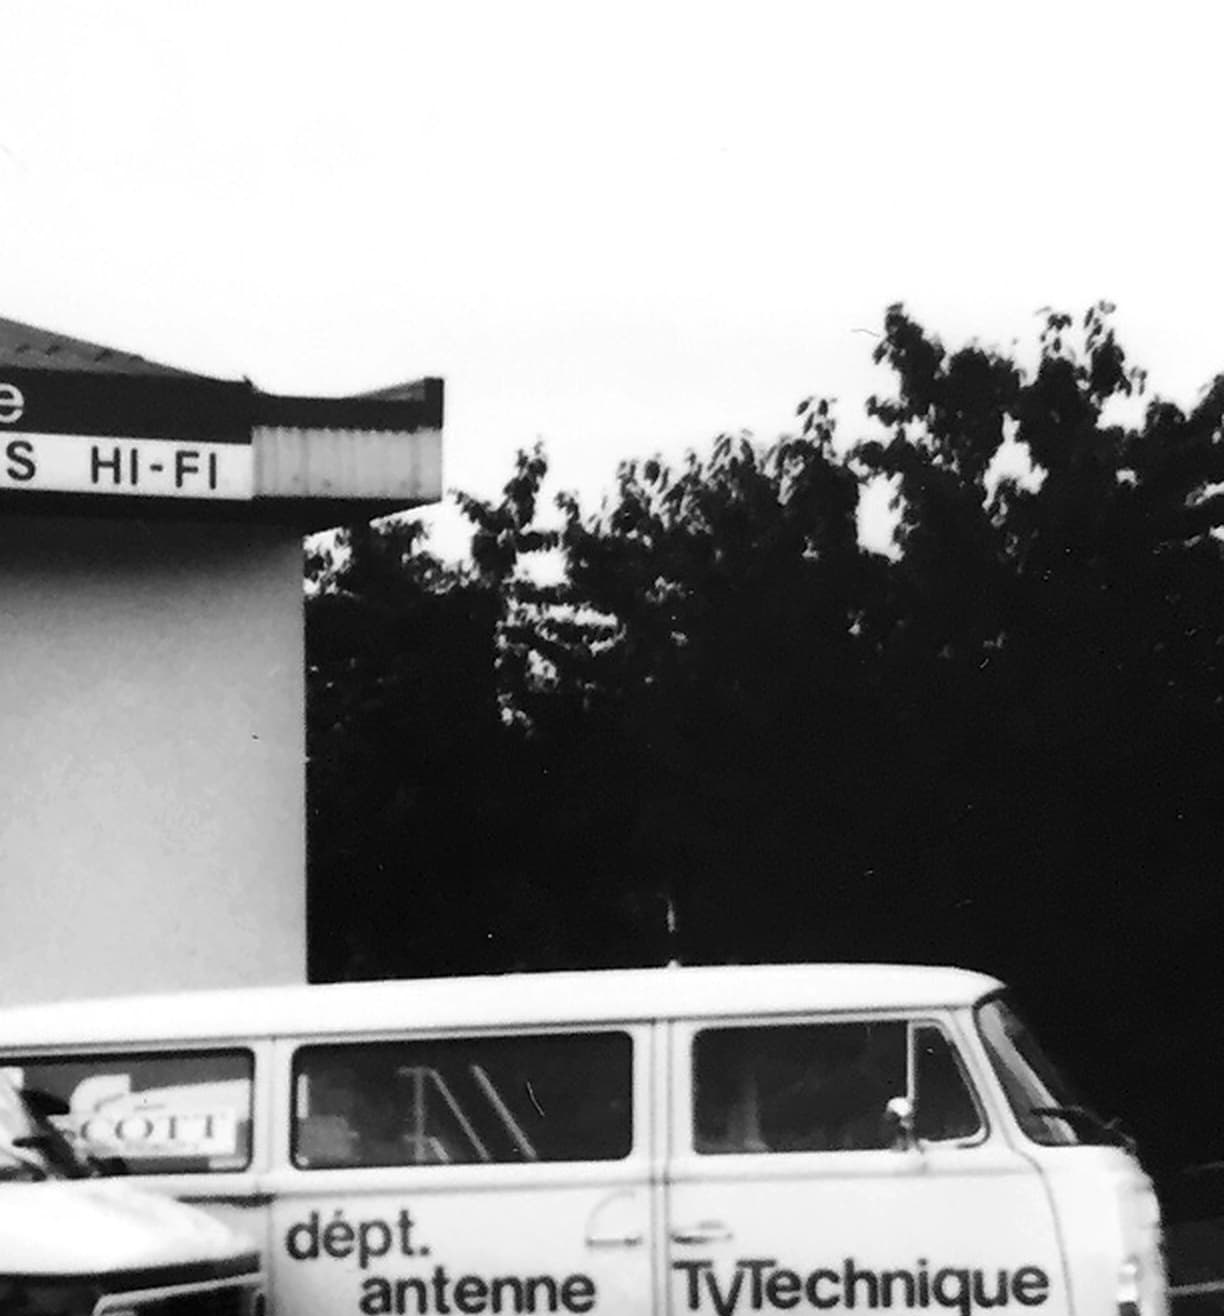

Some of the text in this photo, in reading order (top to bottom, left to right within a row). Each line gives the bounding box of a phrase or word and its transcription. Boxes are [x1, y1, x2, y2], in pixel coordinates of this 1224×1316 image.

[91, 445, 216, 490] HI-FI
[286, 1209, 430, 1268] dépt.
[359, 1265, 596, 1315] antenne
